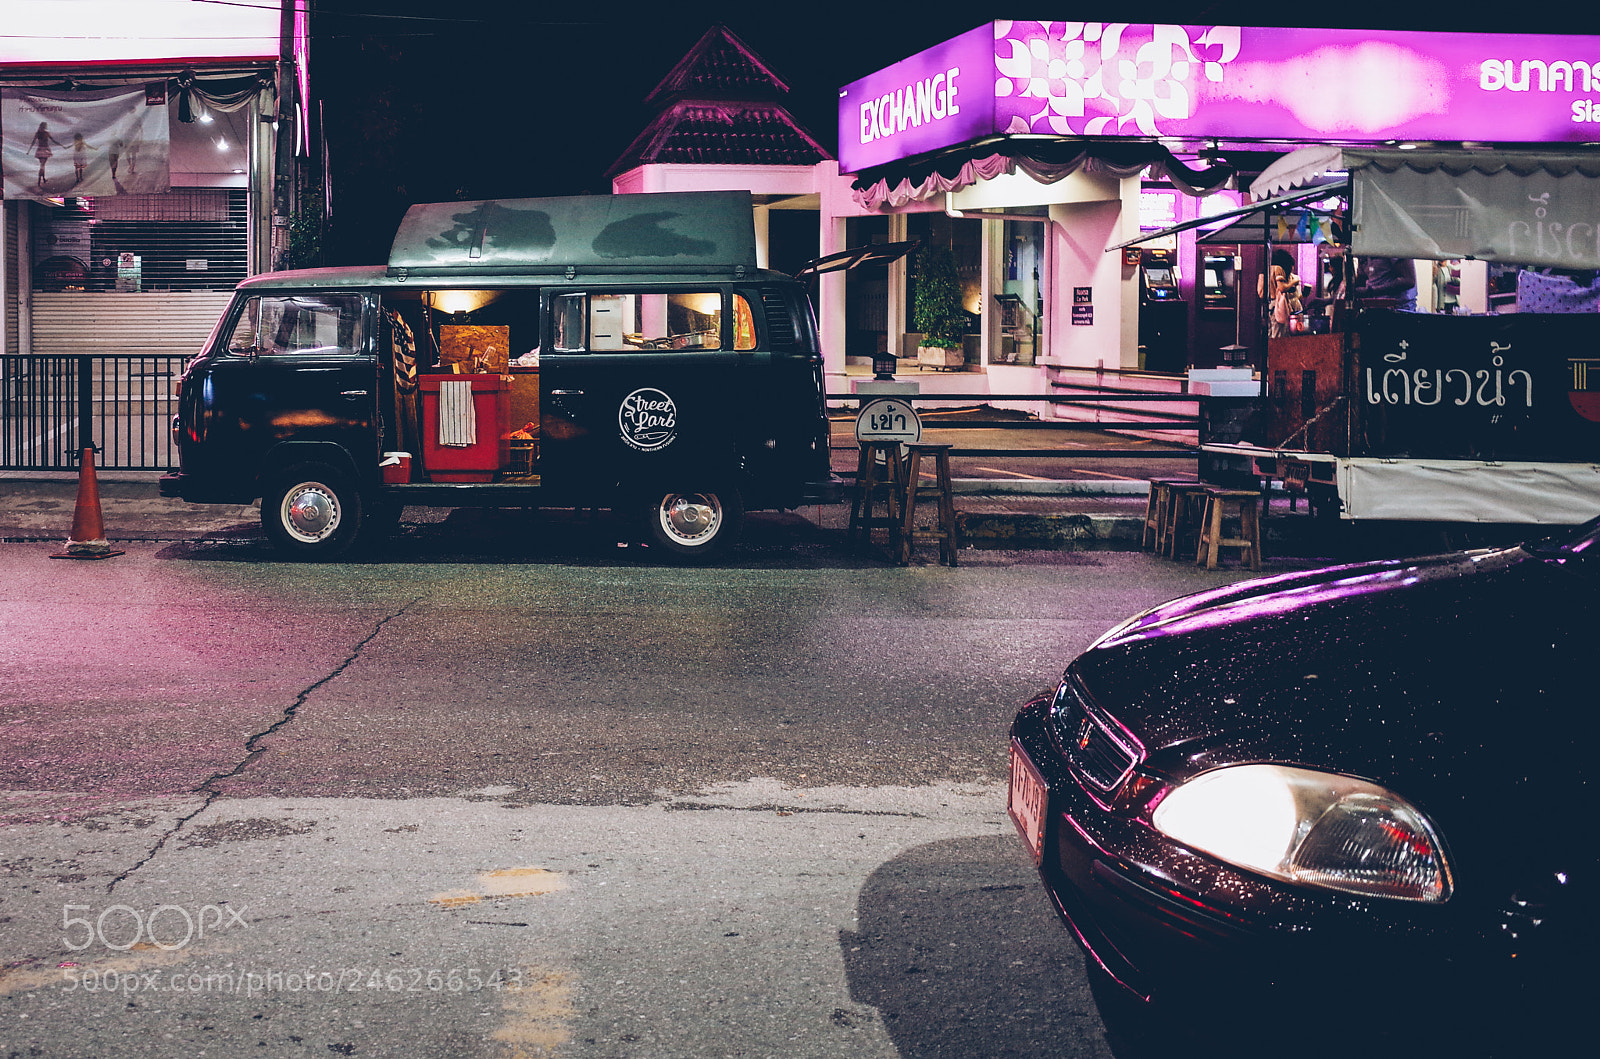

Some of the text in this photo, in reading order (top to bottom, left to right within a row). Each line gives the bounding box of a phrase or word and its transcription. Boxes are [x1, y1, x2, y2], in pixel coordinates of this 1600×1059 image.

[860, 67, 960, 144] EXCHANGE
[1366, 339, 1533, 407] เตี๋ยวน้ำ
[624, 395, 673, 418] Street
[871, 404, 906, 431] เข้า
[634, 411, 675, 433] Larb
